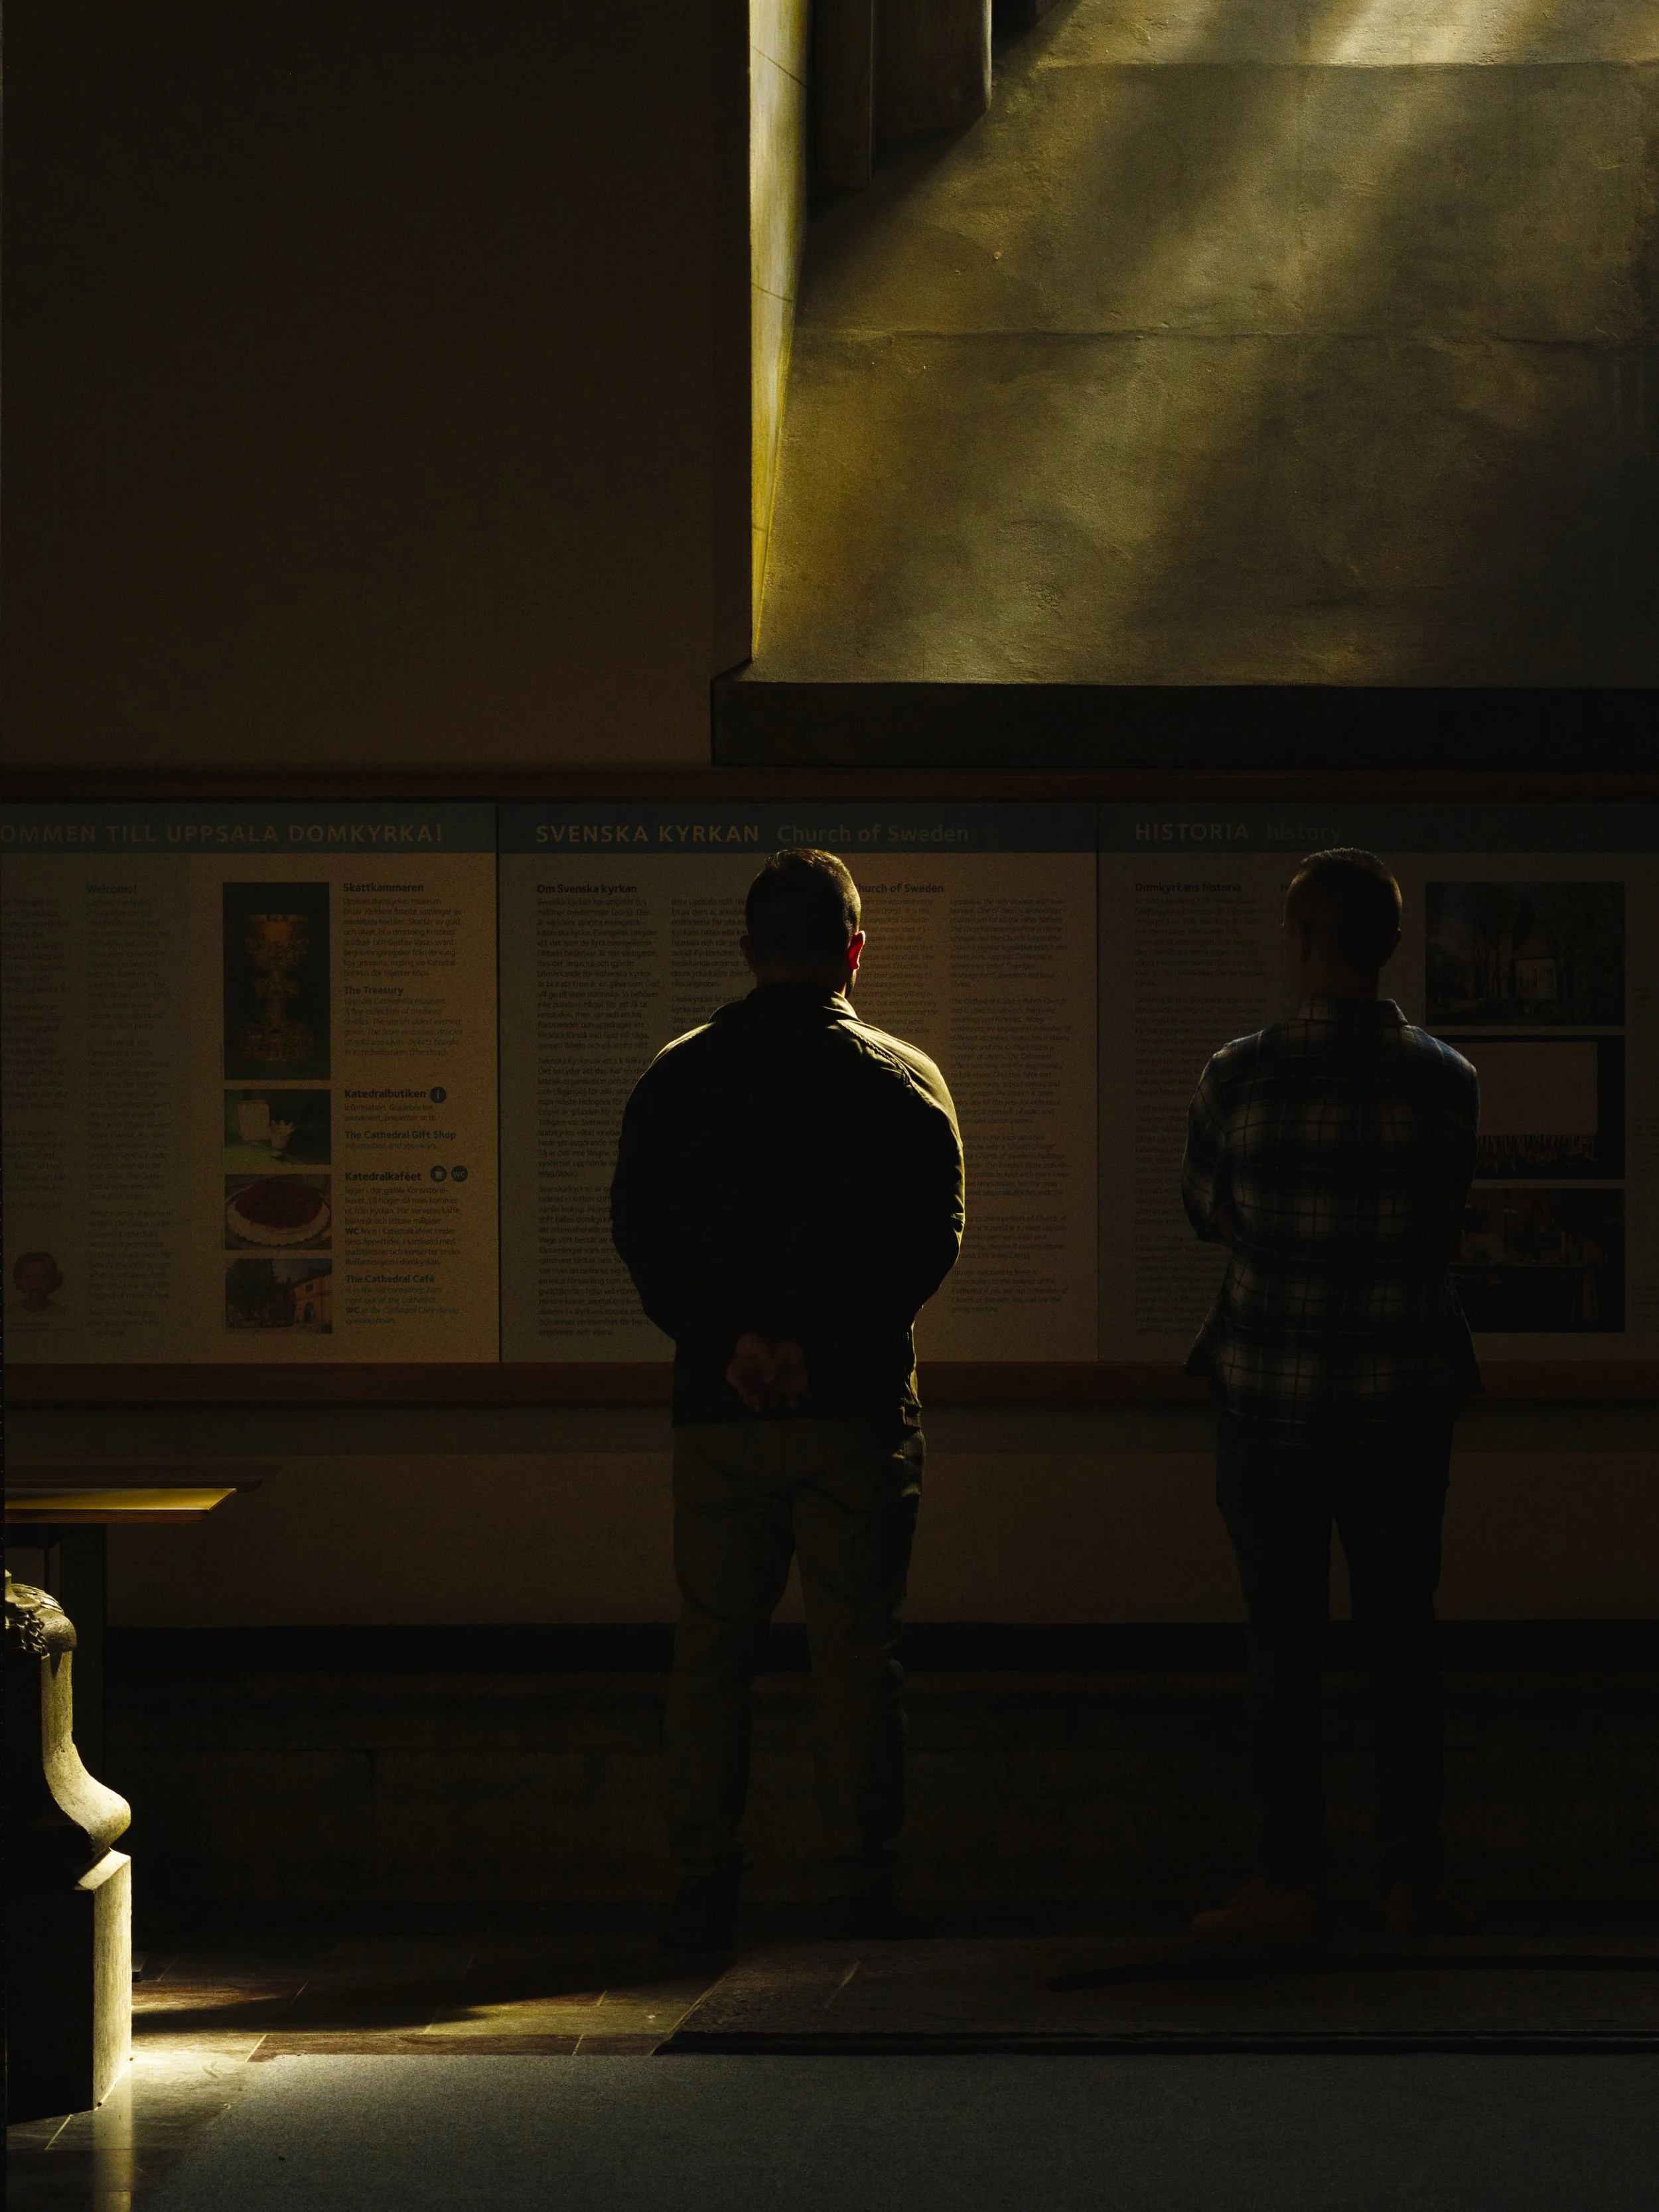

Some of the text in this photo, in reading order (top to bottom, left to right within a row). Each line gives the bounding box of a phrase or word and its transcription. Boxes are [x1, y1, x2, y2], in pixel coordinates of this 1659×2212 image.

[0, 823, 443, 843] OMMEN TILL UPPSALA DOMKYRKA!
[536, 823, 969, 843] SVENSKA KYRKAN Church of Sweden
[1135, 821, 1342, 845] HISTORIA history
[87, 884, 137, 894] Welcome!
[343, 882, 424, 892] Skattkammaren
[537, 884, 637, 895] Om Svenska kyrkan
[855, 883, 944, 892] hurch of Sweden
[1135, 882, 1241, 894] Domkyrkans historia
[363, 986, 403, 996] Treasury
[344, 1089, 427, 1098] Katedralbutiken
[345, 1130, 457, 1141] The Cathedral Gift Shop
[344, 1172, 422, 1181] Katedralkaféet
[346, 1275, 435, 1283] The Cathedral Café
